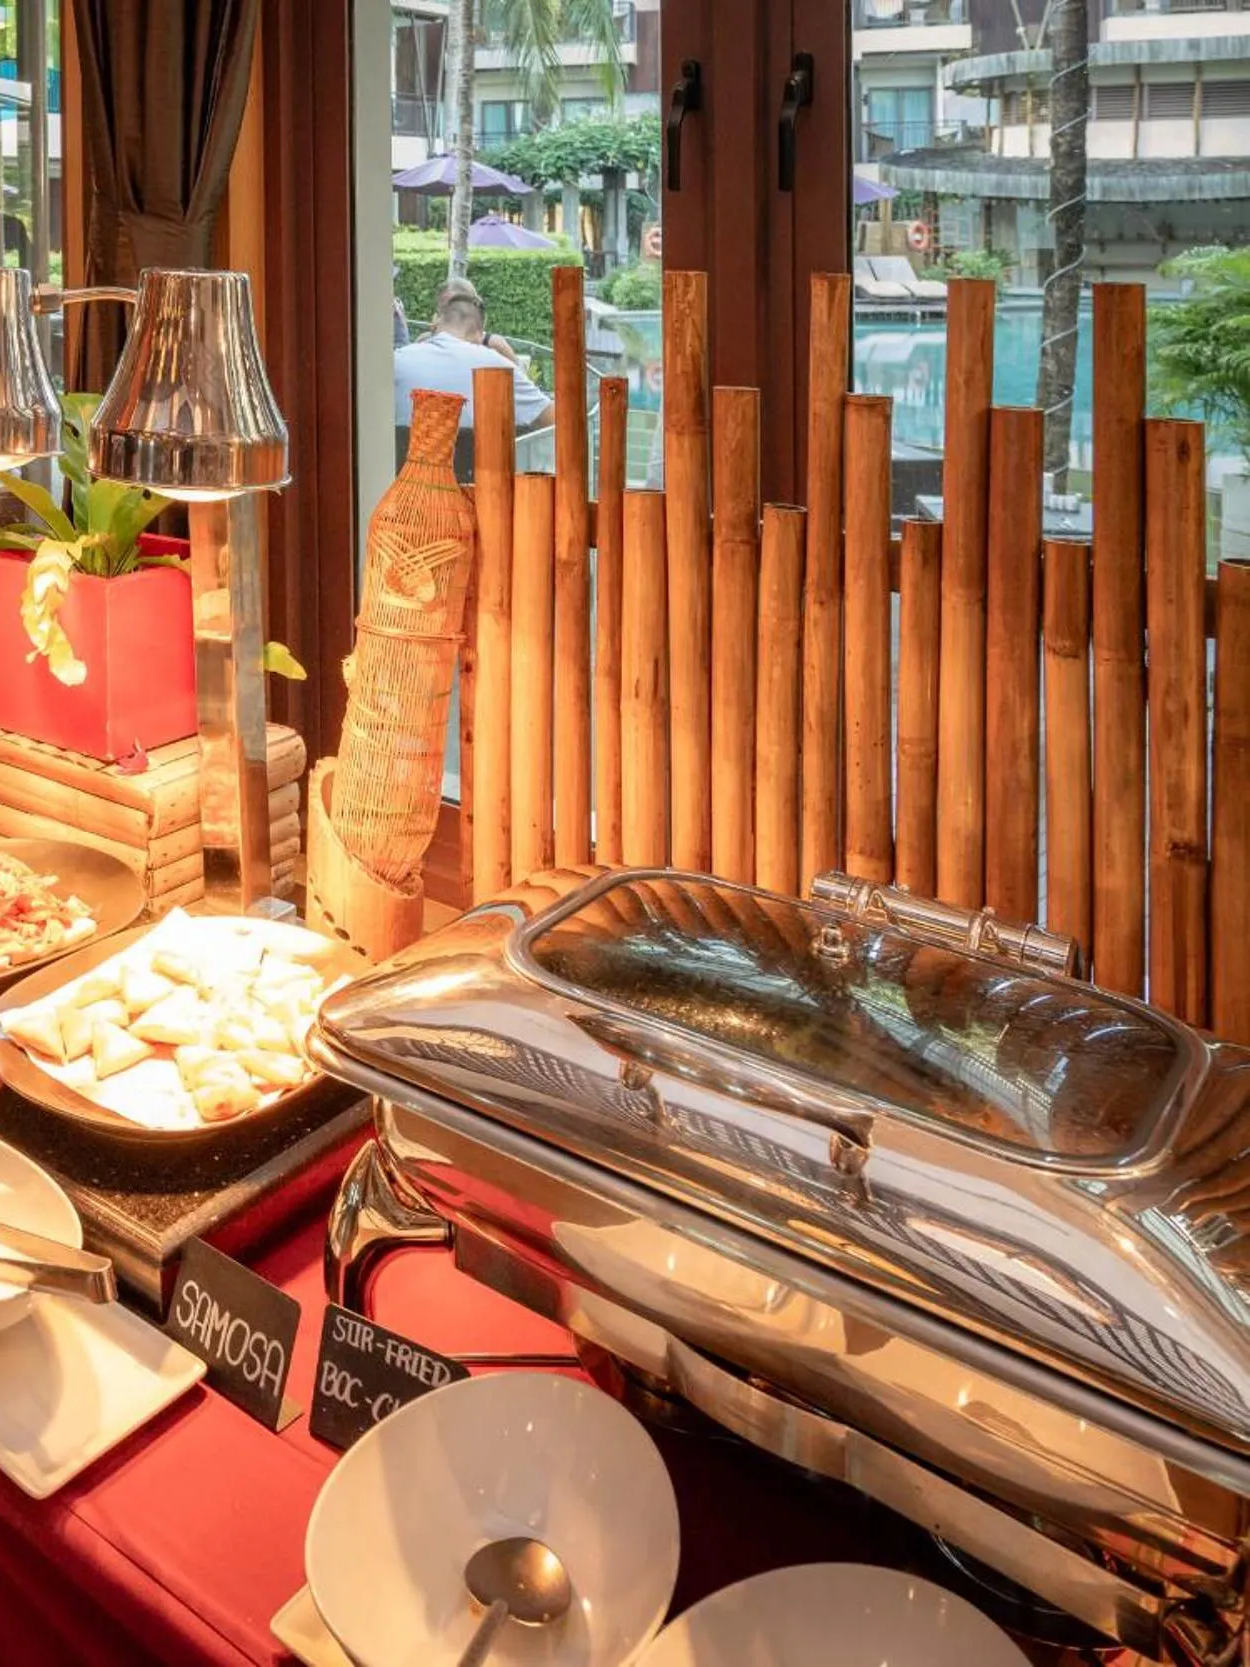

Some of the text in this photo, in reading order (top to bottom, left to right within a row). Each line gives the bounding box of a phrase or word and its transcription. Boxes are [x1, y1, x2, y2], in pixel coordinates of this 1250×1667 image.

[175, 1279, 285, 1398] SAMOSA
[332, 1314, 451, 1388] STIR-FRIED
[319, 1360, 401, 1422] BOC-C
